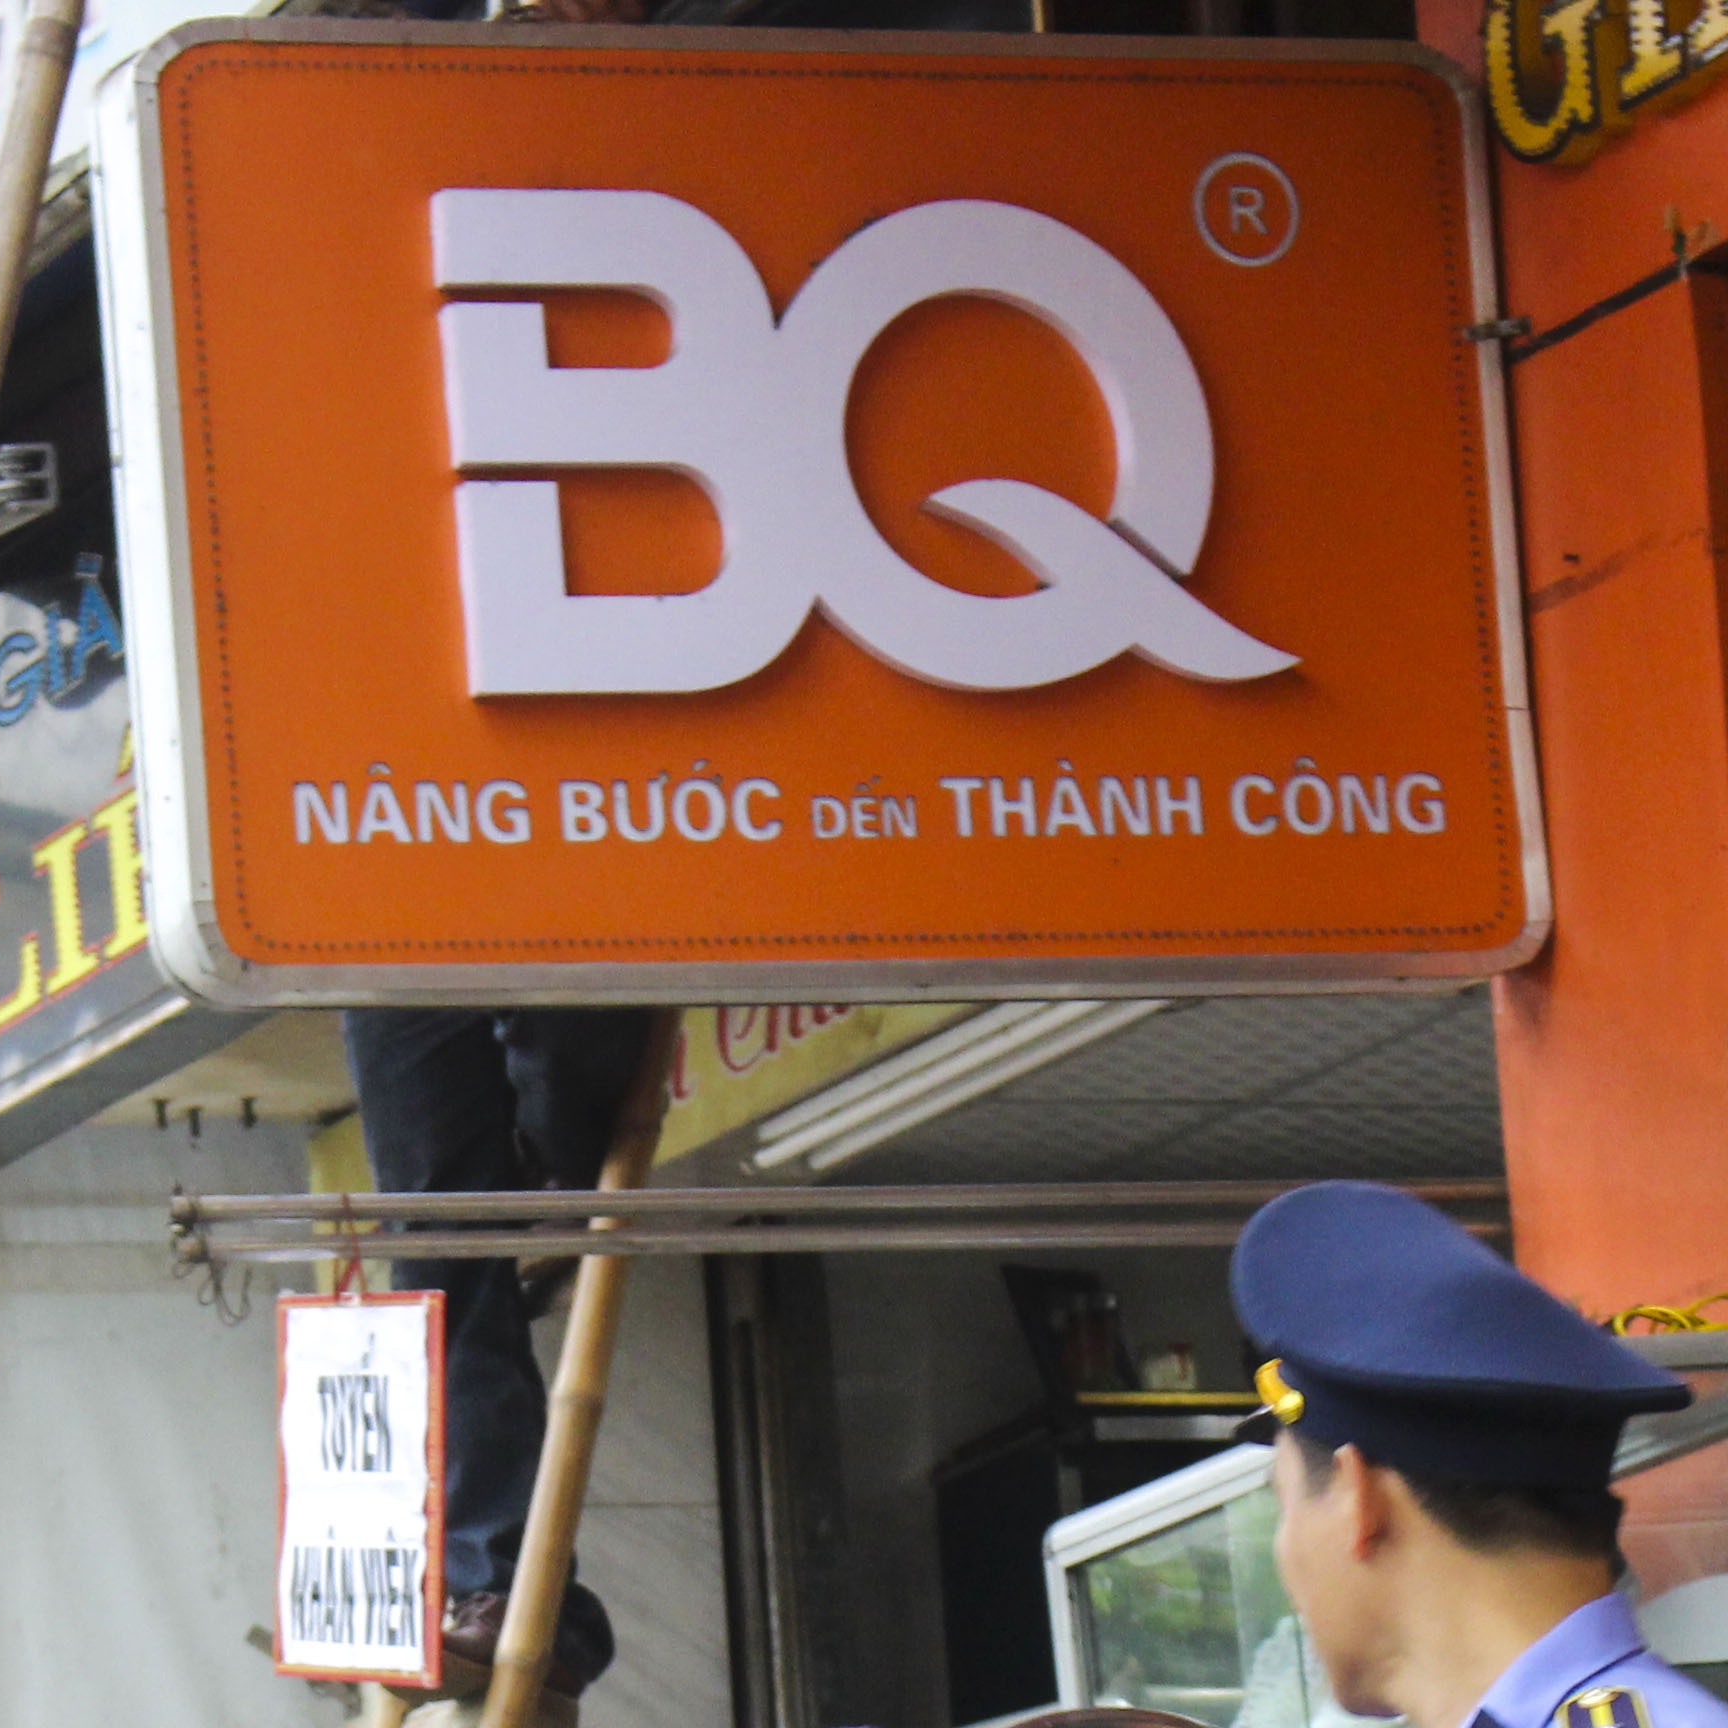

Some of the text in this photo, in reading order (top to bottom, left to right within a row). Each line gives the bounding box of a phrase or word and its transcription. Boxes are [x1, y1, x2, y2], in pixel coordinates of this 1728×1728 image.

[429, 186, 1305, 694] BQ
[291, 756, 1449, 845] NÂNG BƯỚC ĐẾN THÀNH CÔNG
